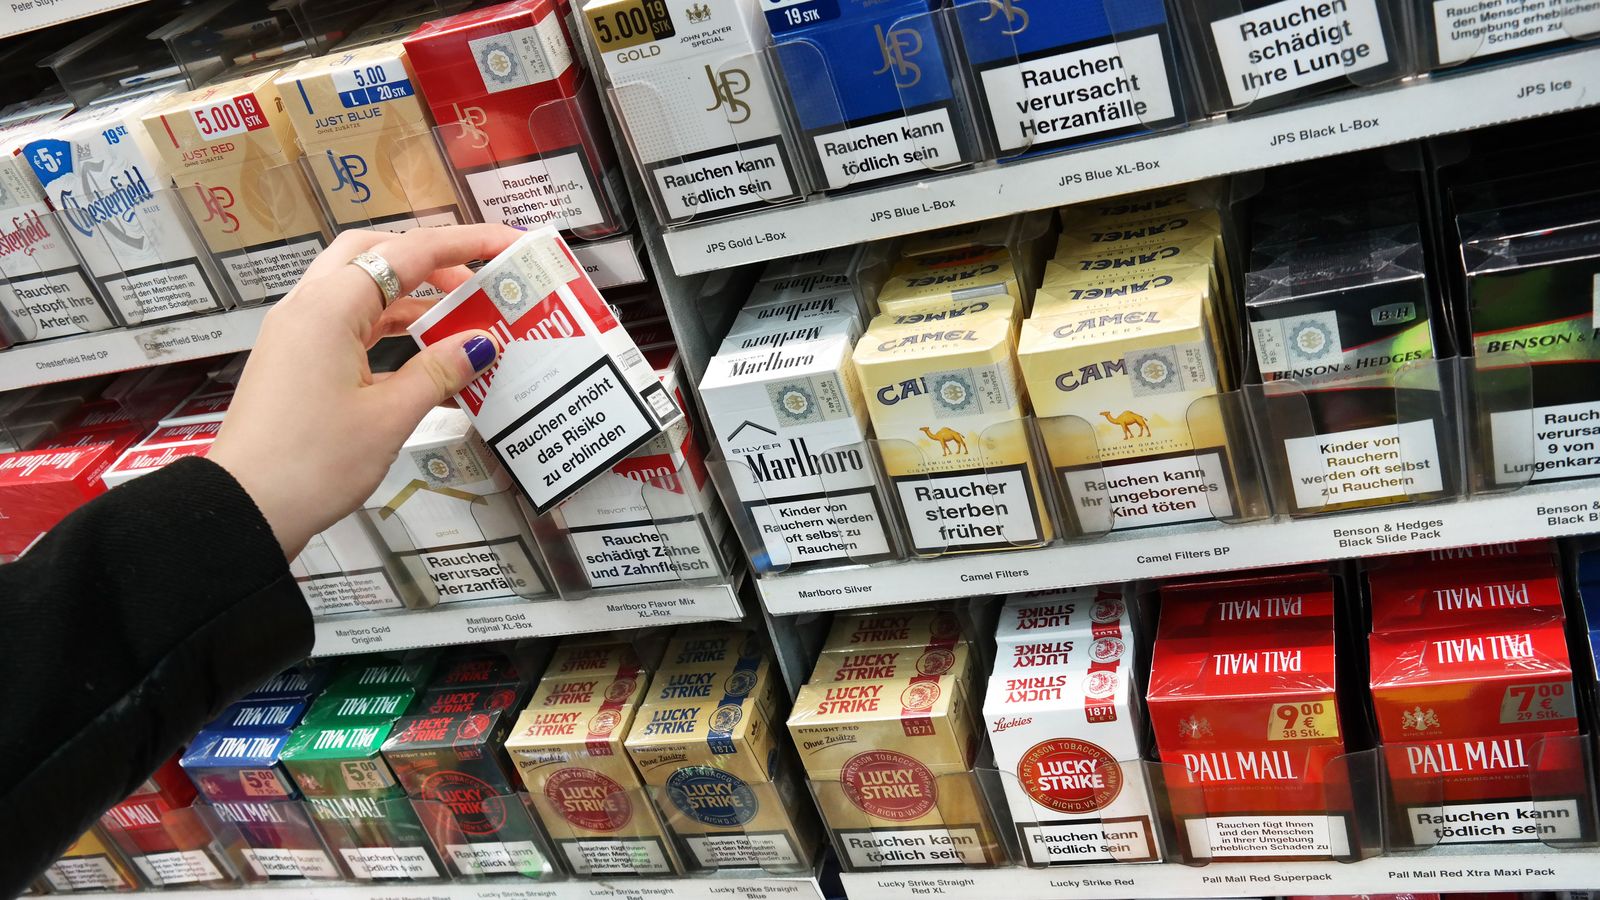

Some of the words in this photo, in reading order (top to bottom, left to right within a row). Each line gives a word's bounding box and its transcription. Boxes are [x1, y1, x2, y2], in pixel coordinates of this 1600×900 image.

[11, 1, 34, 13] Peter
[648, 1, 664, 19] 19
[595, 10, 646, 44] 5.00
[653, 20, 671, 33] STK
[1240, 0, 1348, 42] Rauchen
[680, 34, 700, 43] JOHN
[702, 26, 732, 39] PLAYER
[1451, 21, 1520, 42] Umgebung
[1487, 26, 1544, 45] Schaden
[1547, 22, 1563, 33] zu
[691, 36, 724, 48] SPECIAL
[1248, 20, 1353, 65] schädigt
[616, 45, 661, 63] GOLD
[1242, 67, 1288, 92] Ihre
[1295, 40, 1370, 76] Lunge
[355, 66, 386, 86] 5.00
[349, 92, 358, 105] L
[380, 86, 392, 99] 20
[392, 88, 405, 97] STK
[1517, 84, 1546, 98] JPS
[1550, 80, 1572, 93] Ice
[194, 104, 240, 135] 5.00
[237, 98, 251, 115] 19
[245, 115, 262, 127] STK
[314, 113, 346, 128] JUST
[348, 108, 382, 121] BLUE
[1270, 131, 1296, 147] JPS
[1300, 126, 1336, 141] Black
[1340, 117, 1379, 133] L-Box
[182, 147, 208, 162] JUST
[211, 142, 235, 156] RED
[664, 161, 734, 189] Rauchen
[736, 156, 775, 172] kann
[1059, 175, 1082, 186] JPS
[1086, 168, 1113, 182] Blue
[1115, 160, 1160, 176] XL-Box
[483, 188, 542, 206] verursacht
[543, 182, 583, 200] Mund-,
[682, 185, 736, 207] tödlich
[738, 180, 772, 195] sein
[503, 201, 548, 217] Rachen-
[550, 195, 572, 206] und
[870, 210, 892, 223] JPS
[894, 205, 920, 218] Blue
[922, 199, 955, 212] L-Box
[706, 242, 726, 254] JPS
[728, 237, 753, 249] Gold
[754, 232, 786, 244] L-Box
[1052, 311, 1162, 339] CAMEL
[144, 338, 190, 351] Chesterfield
[192, 333, 210, 342] Blue
[211, 331, 222, 339] OP
[36, 356, 80, 370] Chesterfield
[81, 353, 96, 361] Red
[98, 351, 108, 359] OP
[1273, 364, 1340, 380] BENSON
[1356, 350, 1422, 368] HEDGES
[506, 412, 567, 459] Rauchen
[567, 376, 613, 416] erhöht
[537, 441, 564, 464] das
[564, 410, 606, 445] Risiko
[543, 469, 562, 487] zu
[563, 423, 626, 474] erblinden
[732, 443, 781, 454] SILVER
[746, 437, 863, 483] Marlboro
[1084, 475, 1159, 492] Rauchen
[1164, 468, 1205, 481] kann
[915, 481, 1007, 501] Raucher
[1081, 495, 1102, 507] Ihr
[1108, 482, 1218, 503] ungeborenes
[780, 505, 821, 518] Kinder
[823, 502, 847, 513] von
[925, 504, 1008, 521] sterben
[1112, 505, 1147, 518] Kind
[1152, 500, 1196, 514] töten
[763, 519, 827, 533] Rauchern
[829, 513, 873, 526] werden
[938, 524, 1004, 541] früher
[1333, 527, 1380, 538] Benson
[1384, 524, 1392, 532] &
[1396, 518, 1444, 531] Hedges
[602, 532, 668, 546] Rauchen
[786, 533, 803, 543] oft
[805, 530, 843, 541] selbst
[846, 528, 861, 537] zu
[1338, 537, 1375, 547] Black
[1376, 533, 1408, 544] Slide
[1410, 529, 1441, 541] Pack
[586, 547, 651, 564] schädigt
[654, 544, 700, 558] Zähne
[797, 542, 857, 555] Rauchern
[1137, 554, 1171, 564] Camel
[1175, 549, 1211, 561] Filters
[1214, 547, 1230, 557] BP
[591, 568, 618, 580] und
[623, 559, 709, 577] Zahnfleisch
[799, 589, 842, 599] Marlboro
[844, 585, 872, 594] Silver
[606, 603, 646, 612] Marlboro
[648, 600, 677, 609] Flavor
[679, 598, 695, 606] Mix
[638, 608, 670, 618] XL-Box
[466, 616, 502, 625] Marlboro
[505, 613, 525, 622] Gold
[467, 623, 499, 633] Original
[502, 620, 533, 630] XL-Box
[1037, 759, 1098, 775] LUCKY
[1184, 751, 1237, 782] PALL
[1240, 750, 1298, 780] MALL
[1039, 775, 1104, 791] STRIKE
[1417, 808, 1513, 824] Rauchen
[1517, 806, 1570, 819] kann
[1216, 821, 1260, 829] Rauchen
[1262, 821, 1282, 829] fügt
[1434, 825, 1505, 838] tödlich
[1511, 824, 1556, 835] sein
[1033, 832, 1100, 843] Rauchen
[1103, 830, 1137, 839] kann
[1259, 836, 1314, 844] Umgebung
[1049, 844, 1098, 854] tödlich
[1101, 843, 1131, 852] sein
[1202, 875, 1222, 884] Pall
[1225, 874, 1247, 883] Mall
[1250, 874, 1271, 883] Red
[1274, 872, 1333, 884] Superpack
[1388, 871, 1411, 879] Pall
[1412, 870, 1437, 878] Mall
[1440, 869, 1463, 878] Red
[1466, 869, 1492, 877] Xtra
[1494, 868, 1523, 876] Maxi
[1525, 867, 1556, 877] Pack
[1050, 880, 1079, 888] Lucky
[1082, 879, 1108, 887] Strike
